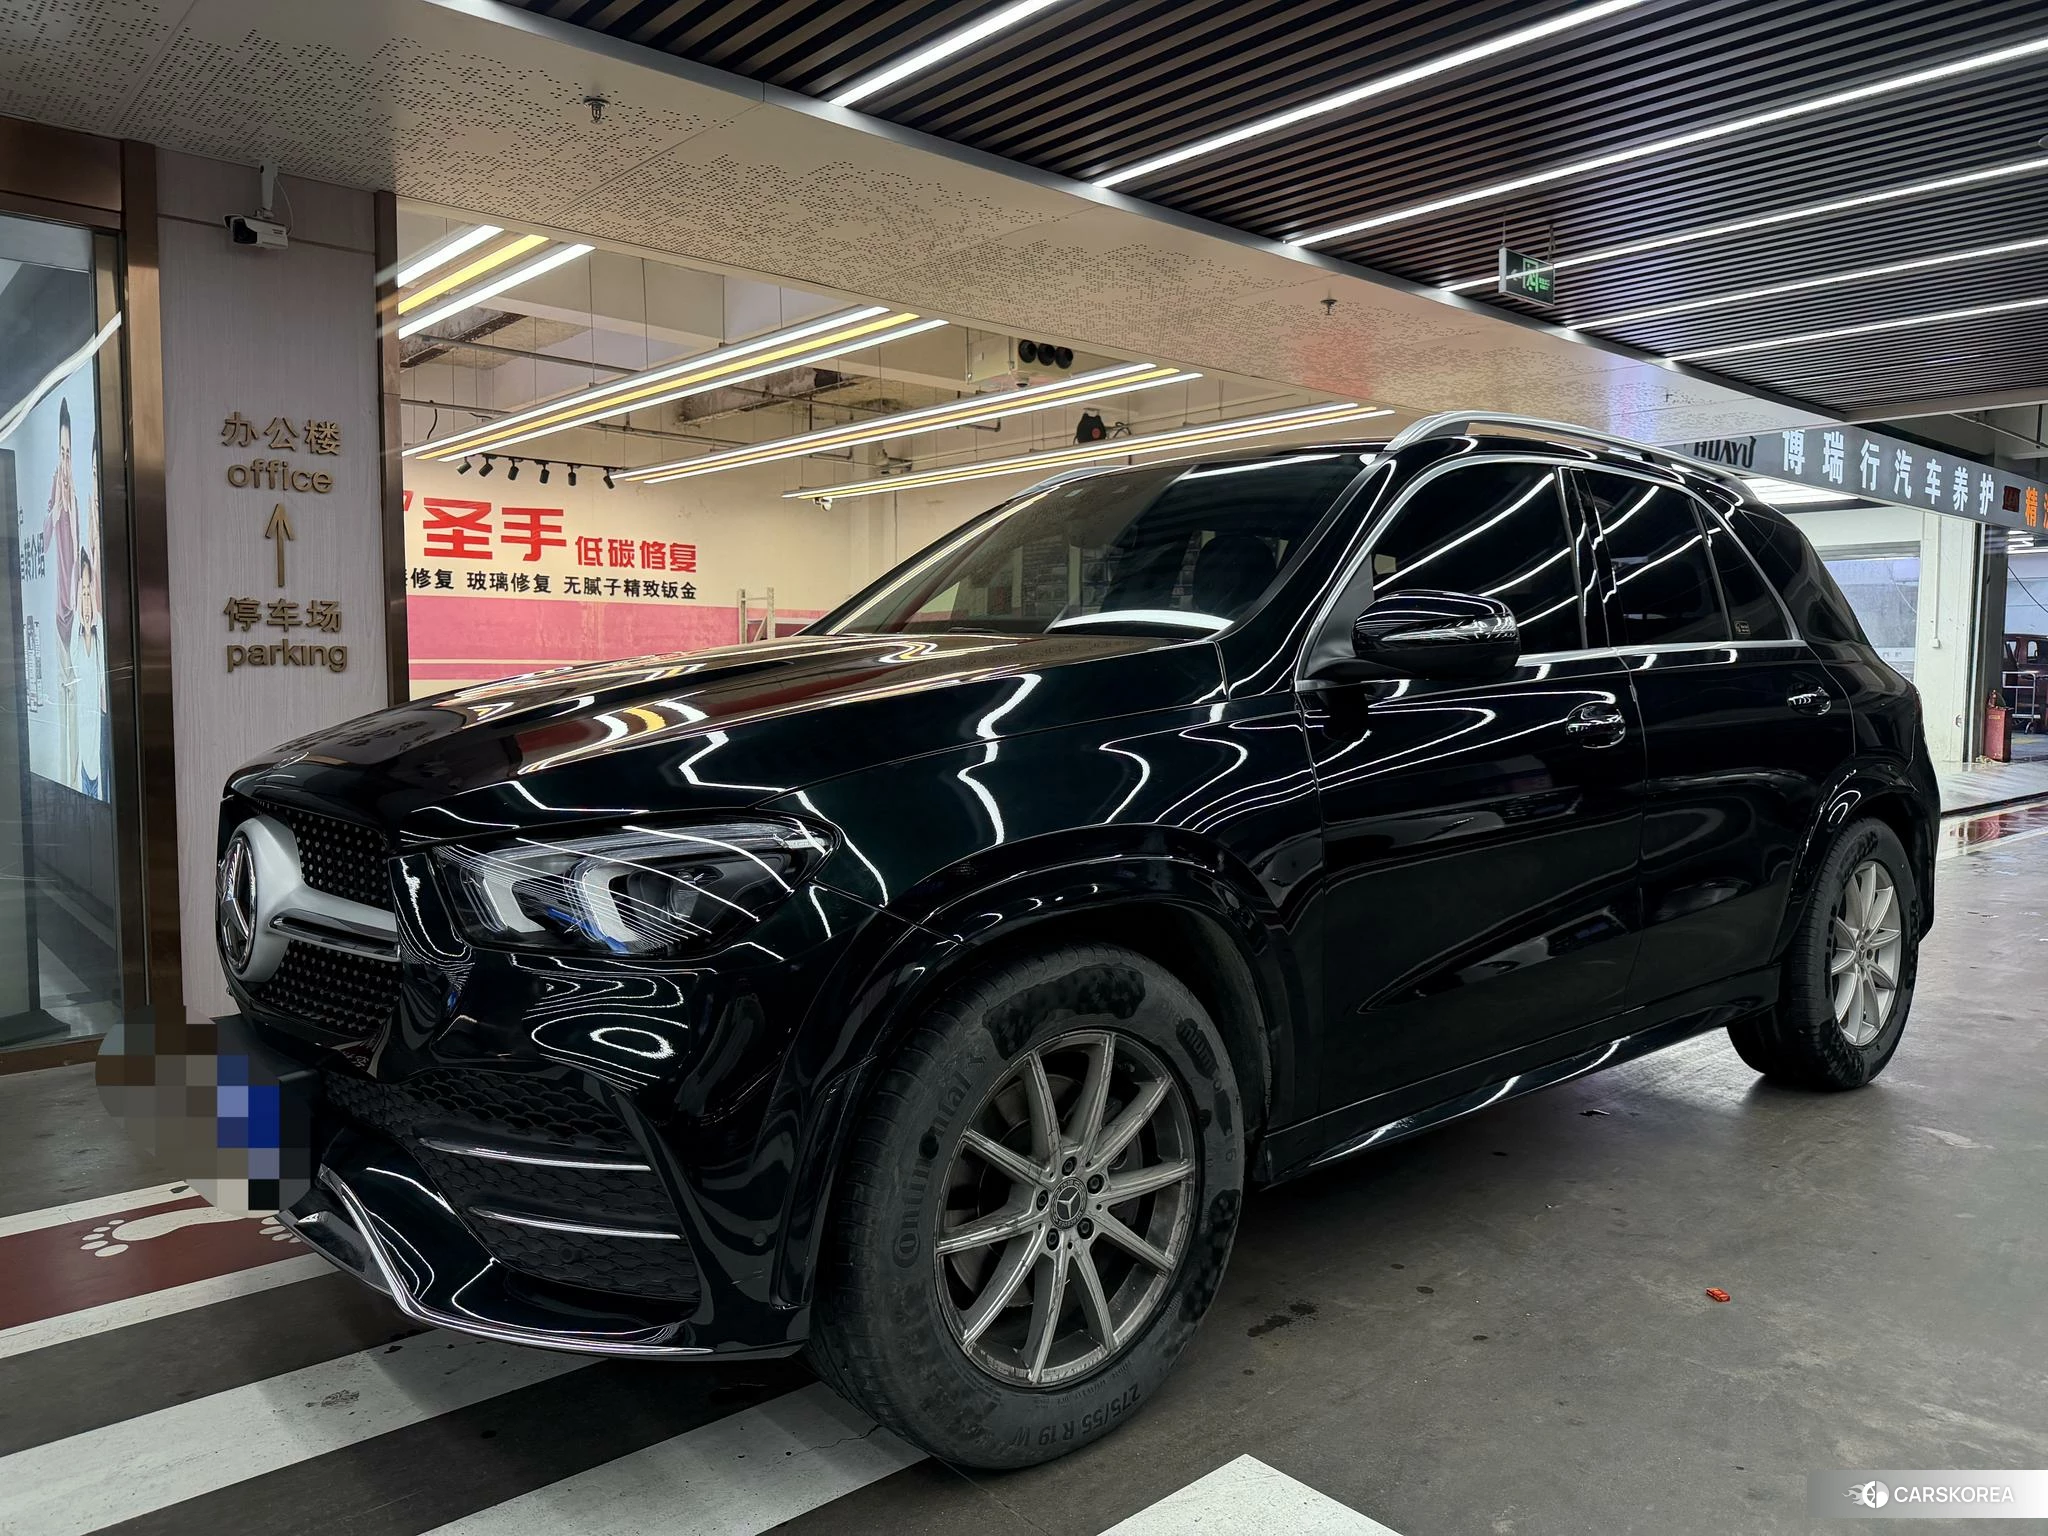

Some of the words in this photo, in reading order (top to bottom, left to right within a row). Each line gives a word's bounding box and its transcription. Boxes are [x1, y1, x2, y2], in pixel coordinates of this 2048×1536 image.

[221, 412, 341, 455] 办公楼
[228, 458, 334, 493] office
[1783, 429, 1994, 515] 博瑞行汽车养护
[403, 490, 568, 562] 圣手
[575, 536, 697, 574] 低碳修复
[403, 567, 455, 590] 修复
[467, 571, 552, 595] 玻璃修复
[563, 575, 697, 600] 无腻子精致钣金
[223, 598, 342, 634] 停车场
[226, 639, 348, 674] parking
[1081, 1383, 1141, 1435] 275/55
[1038, 1424, 1058, 1446] 19
[1062, 1420, 1075, 1441] R
